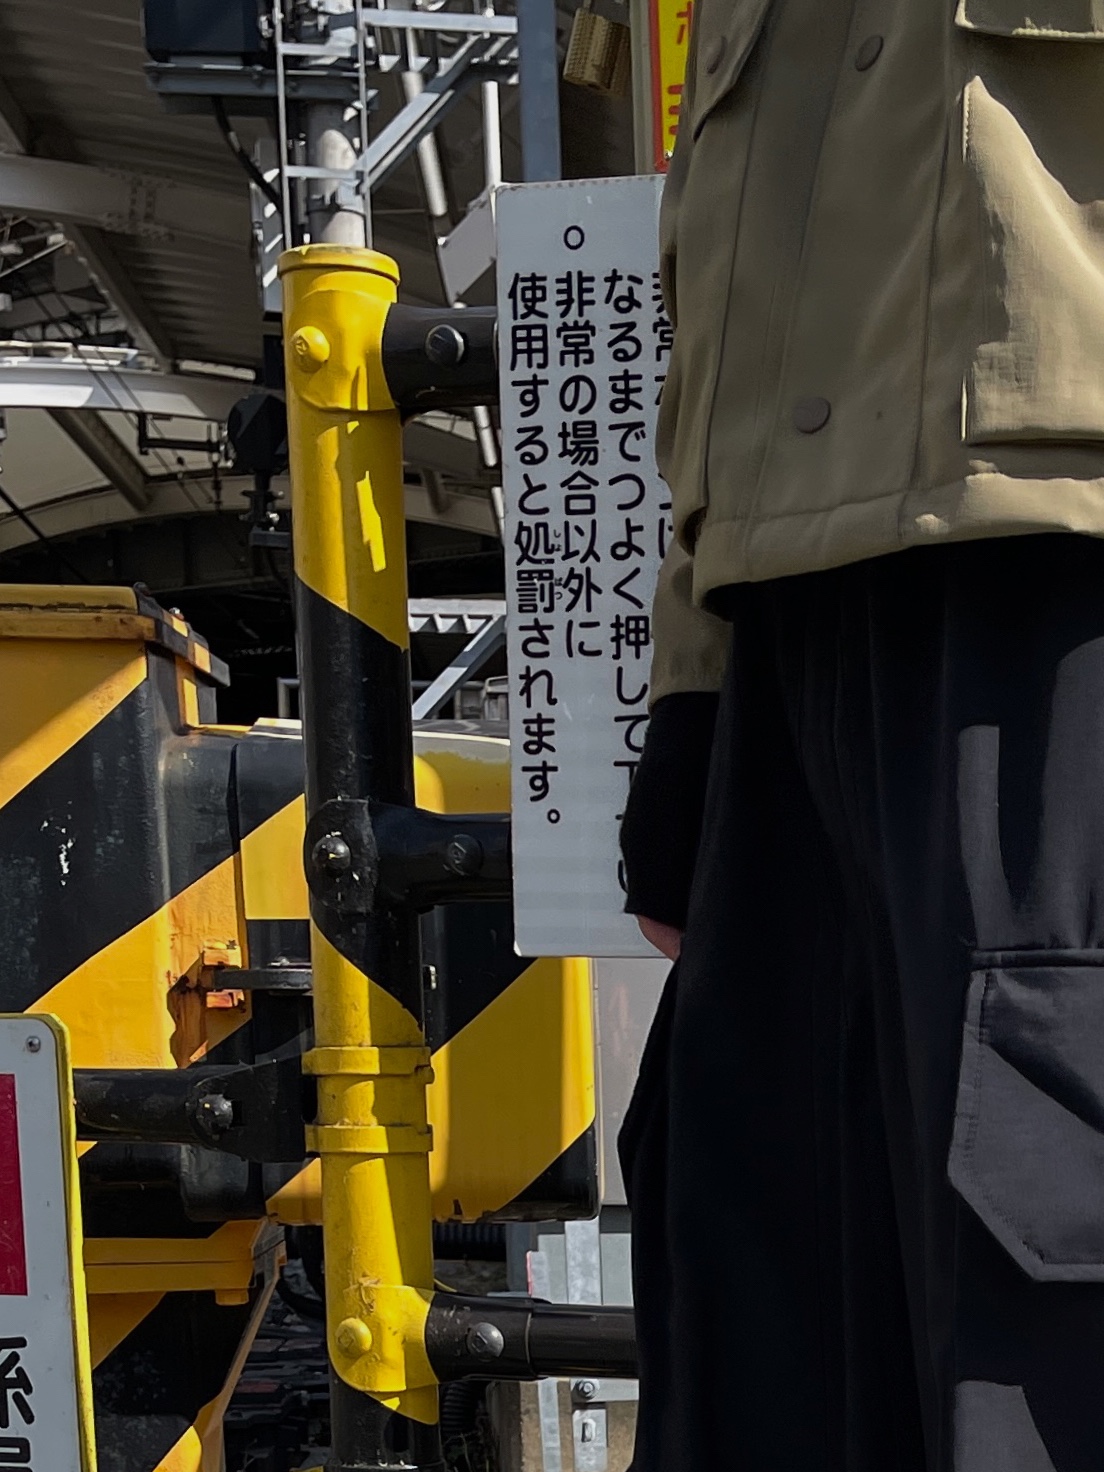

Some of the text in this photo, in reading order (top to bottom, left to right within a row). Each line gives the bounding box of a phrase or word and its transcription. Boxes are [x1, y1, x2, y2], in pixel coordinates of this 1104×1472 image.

[508, 272, 561, 824] 使用すると処罰されます。
[555, 270, 603, 658] 非常の場合以外に
[603, 268, 652, 894] なるまでつよく押して
